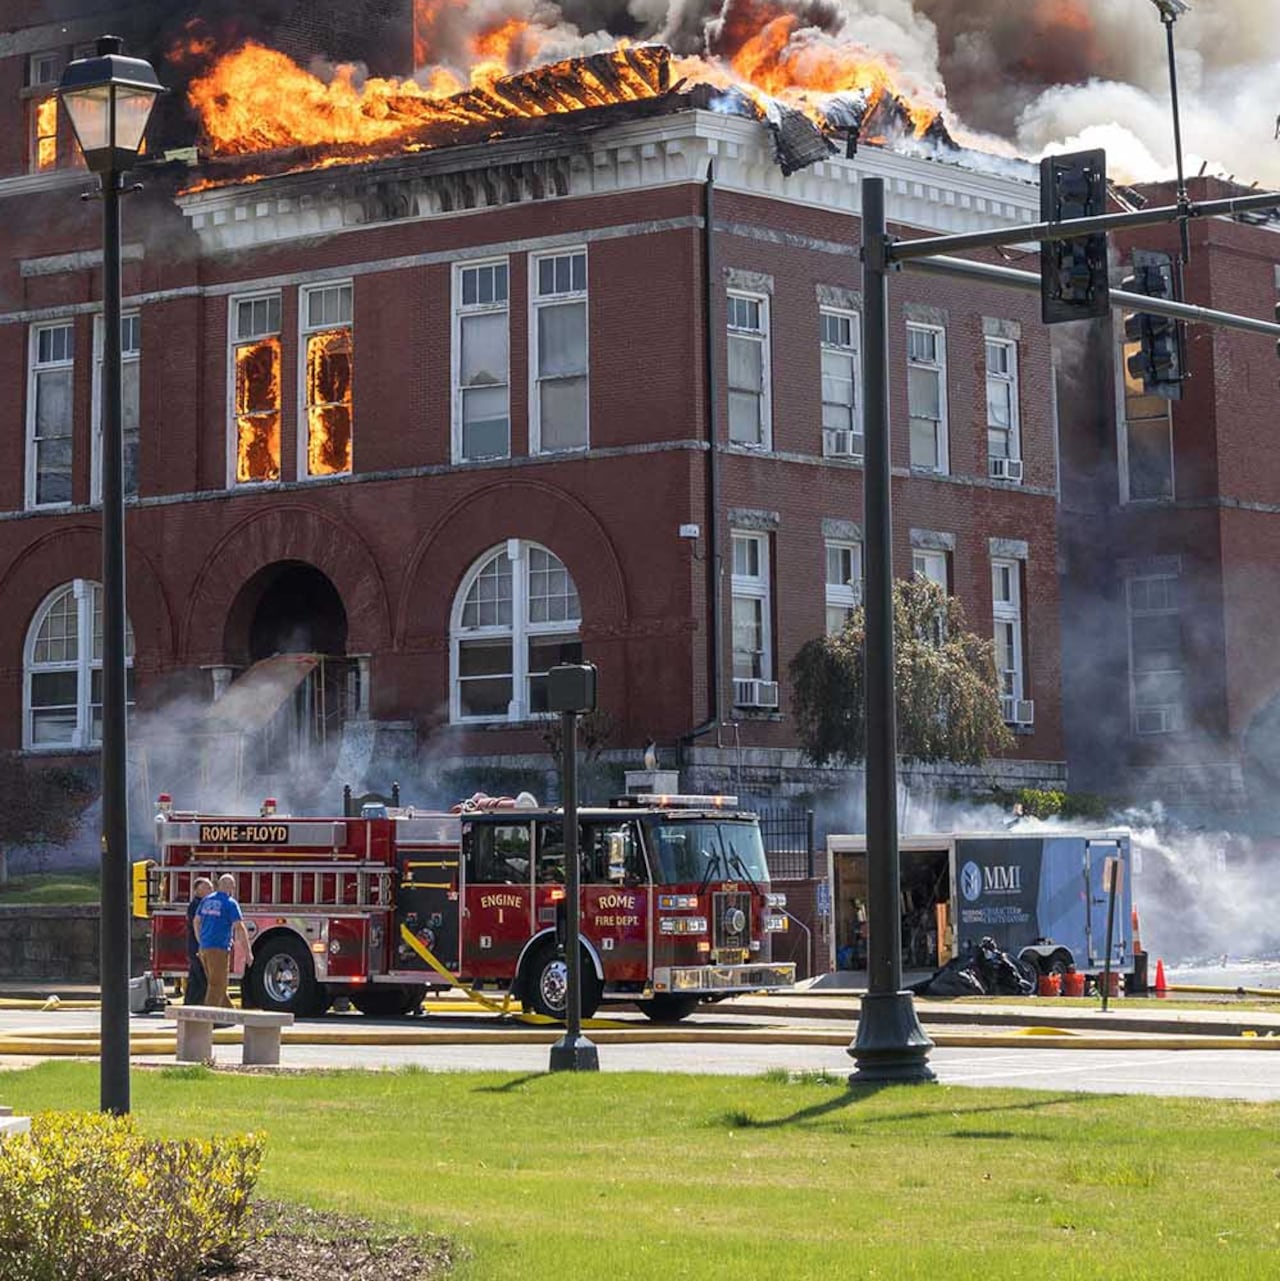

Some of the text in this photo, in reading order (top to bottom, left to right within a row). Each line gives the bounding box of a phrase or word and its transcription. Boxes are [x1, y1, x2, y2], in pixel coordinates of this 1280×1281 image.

[984, 866, 1021, 890] MMI
[480, 894, 522, 908] ENGINE
[598, 895, 636, 909] ROME
[498, 909, 504, 923] 1
[595, 916, 615, 926] FIRE
